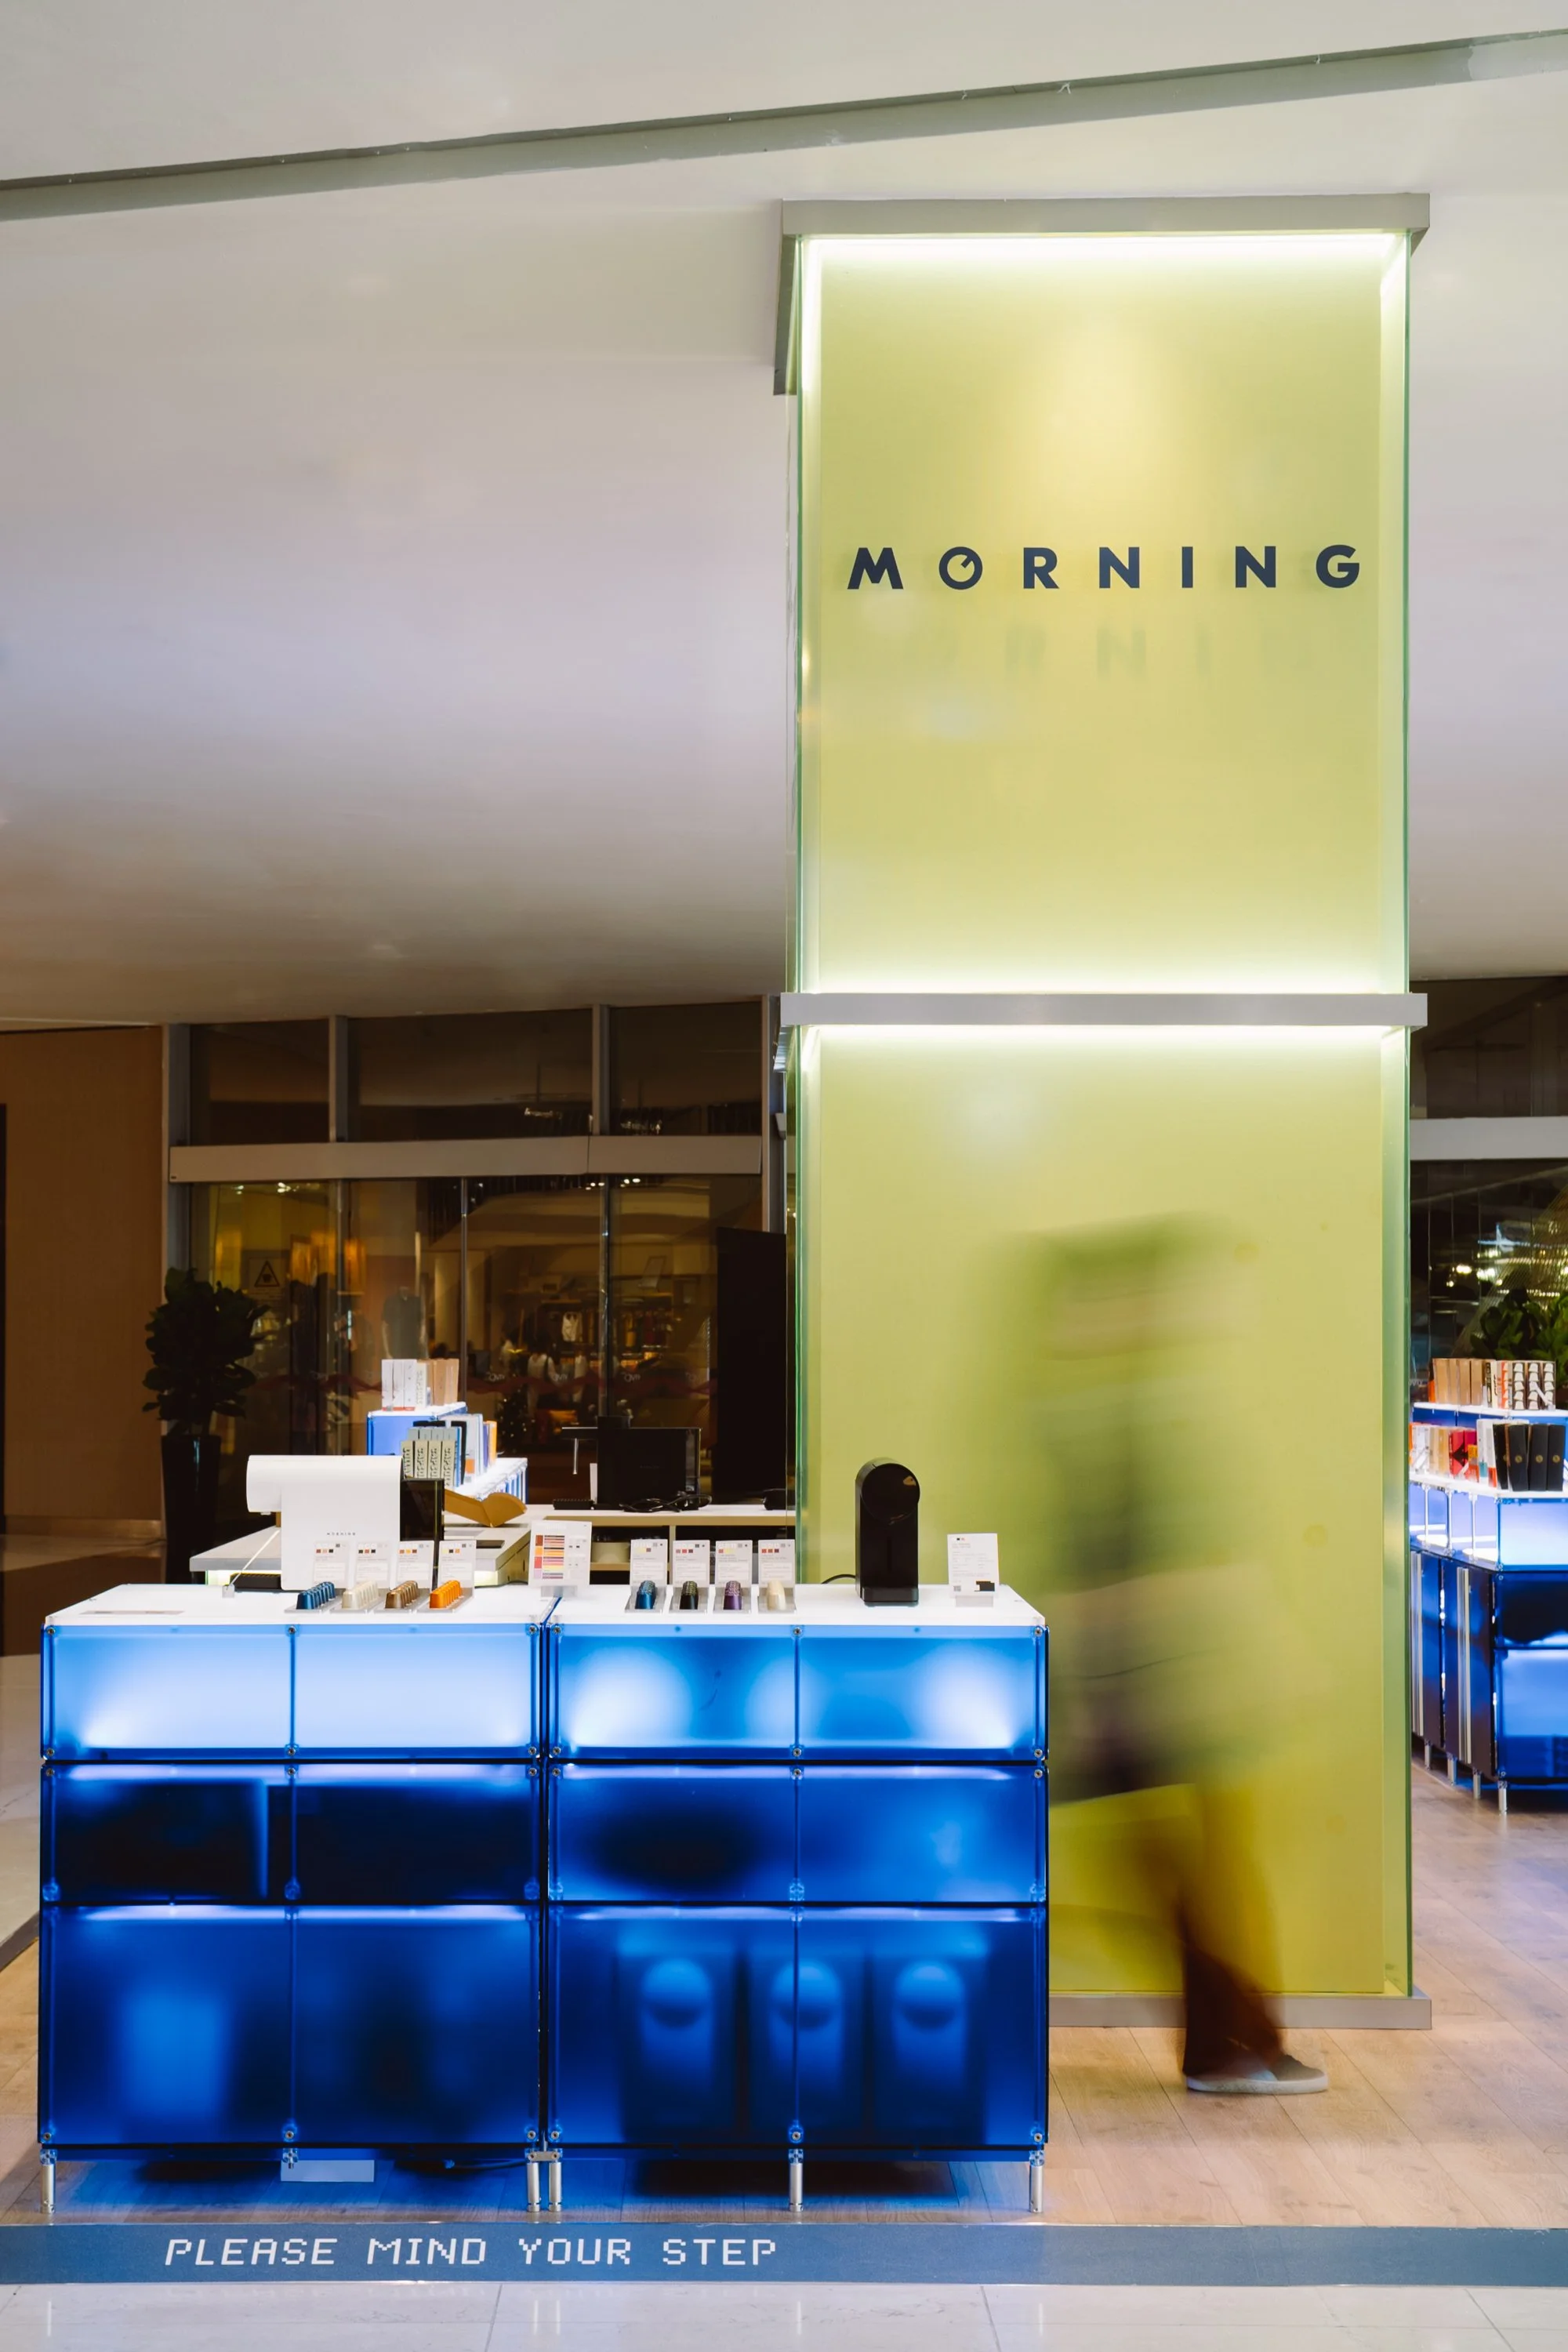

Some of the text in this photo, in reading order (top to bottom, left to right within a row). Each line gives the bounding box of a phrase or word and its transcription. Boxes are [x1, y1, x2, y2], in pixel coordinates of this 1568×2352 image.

[848, 545, 1359, 590] MORNING
[165, 2238, 776, 2266] PLEASE MIND YOUR STEP
